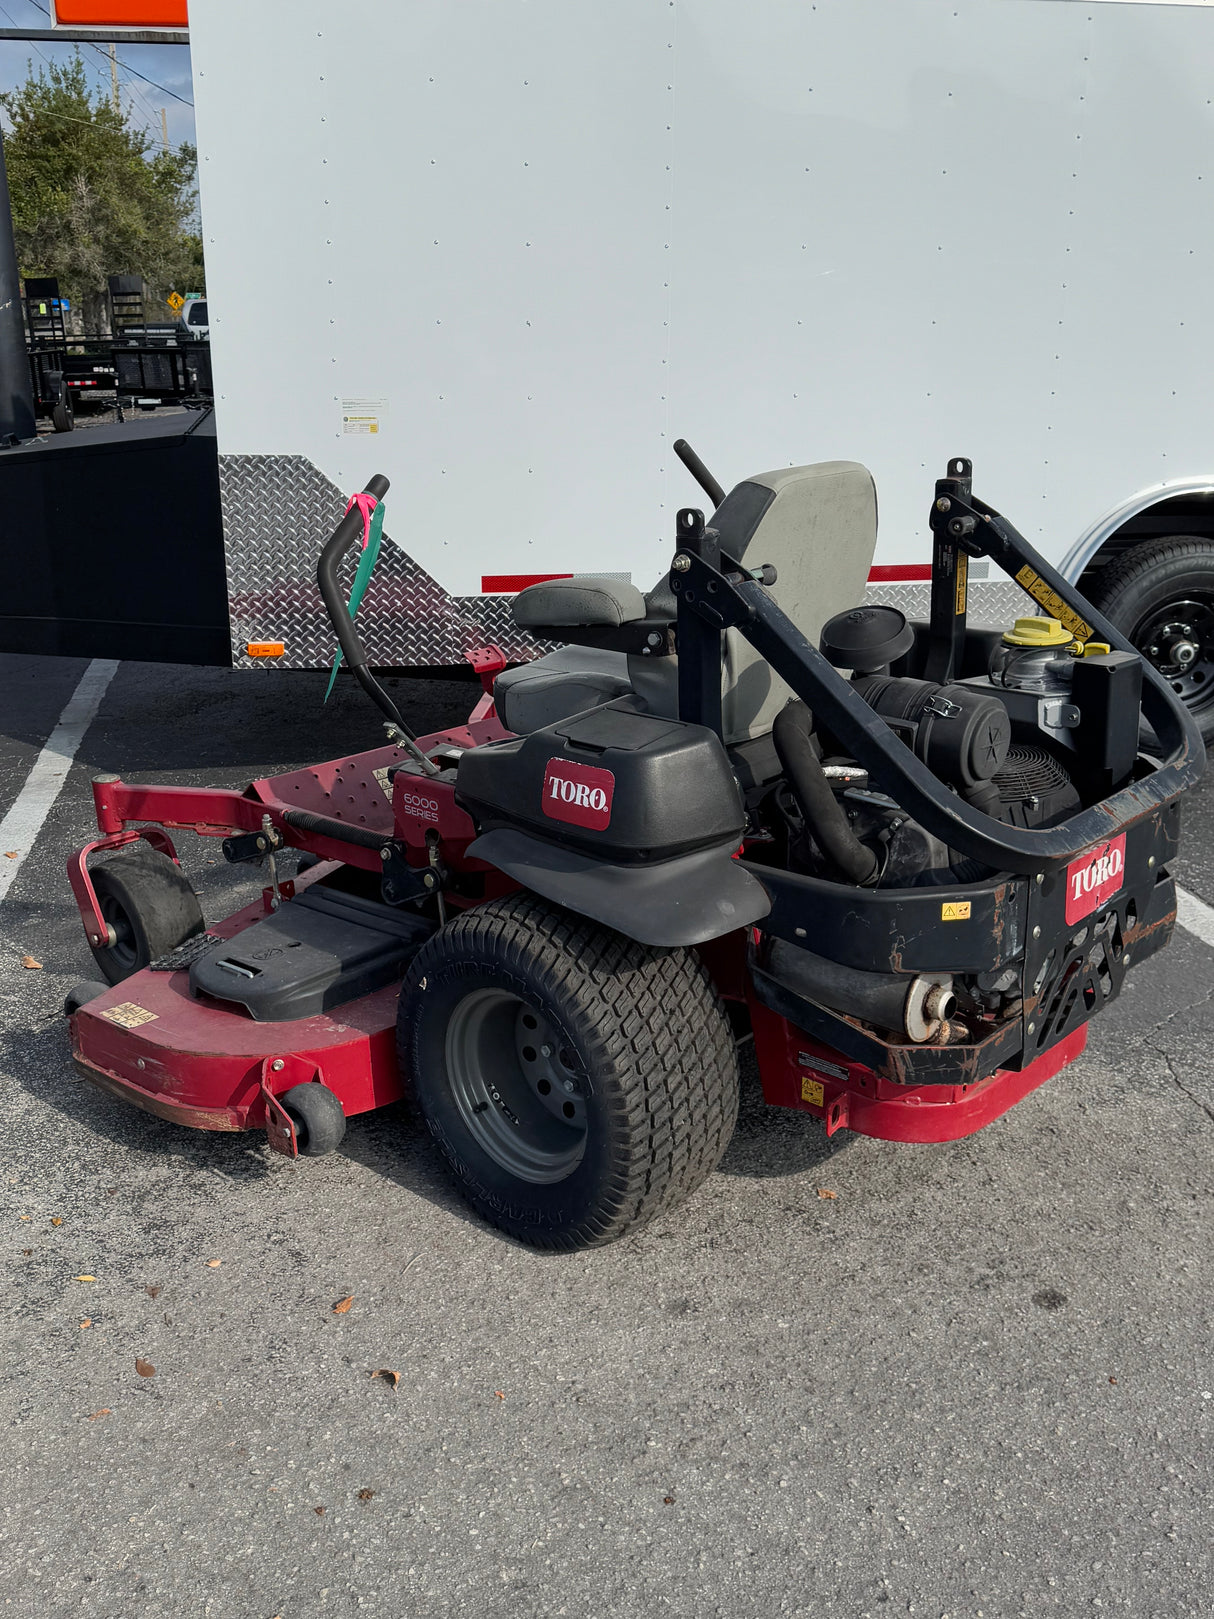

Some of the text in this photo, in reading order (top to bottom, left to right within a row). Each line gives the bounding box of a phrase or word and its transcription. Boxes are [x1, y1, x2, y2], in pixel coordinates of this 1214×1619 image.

[403, 793, 439, 811] 6000
[548, 776, 607, 811] TORO
[404, 804, 439, 822] SERIES
[1071, 848, 1122, 901] TORO
